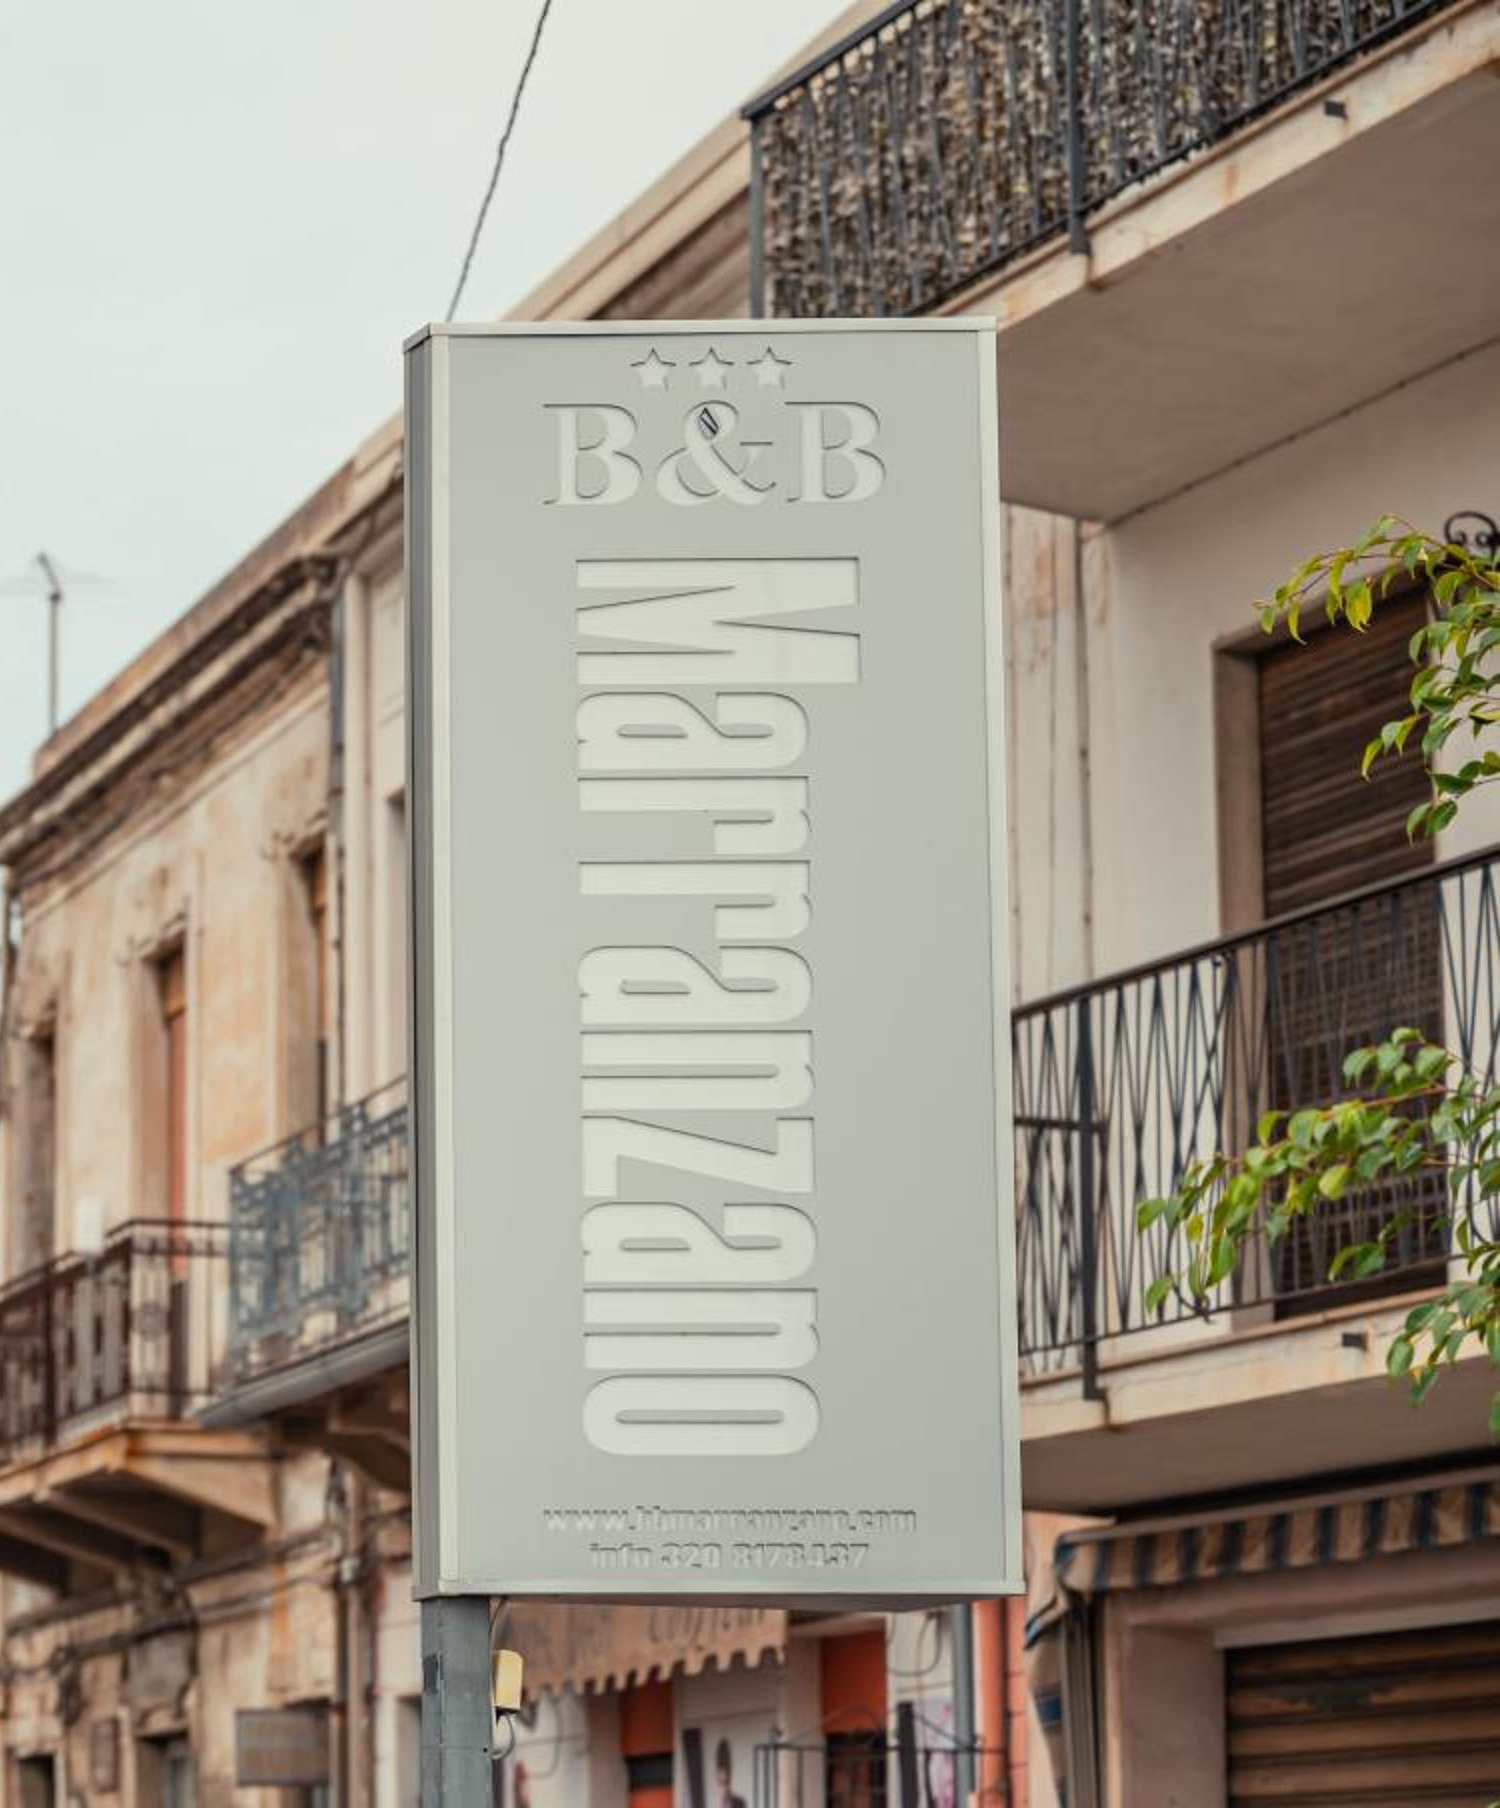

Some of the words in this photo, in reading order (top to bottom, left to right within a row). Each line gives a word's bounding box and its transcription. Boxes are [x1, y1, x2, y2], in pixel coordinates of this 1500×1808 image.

[575, 556, 862, 1456] Marranzano
[589, 1543, 652, 1569] info
[661, 1543, 722, 1569] 320
